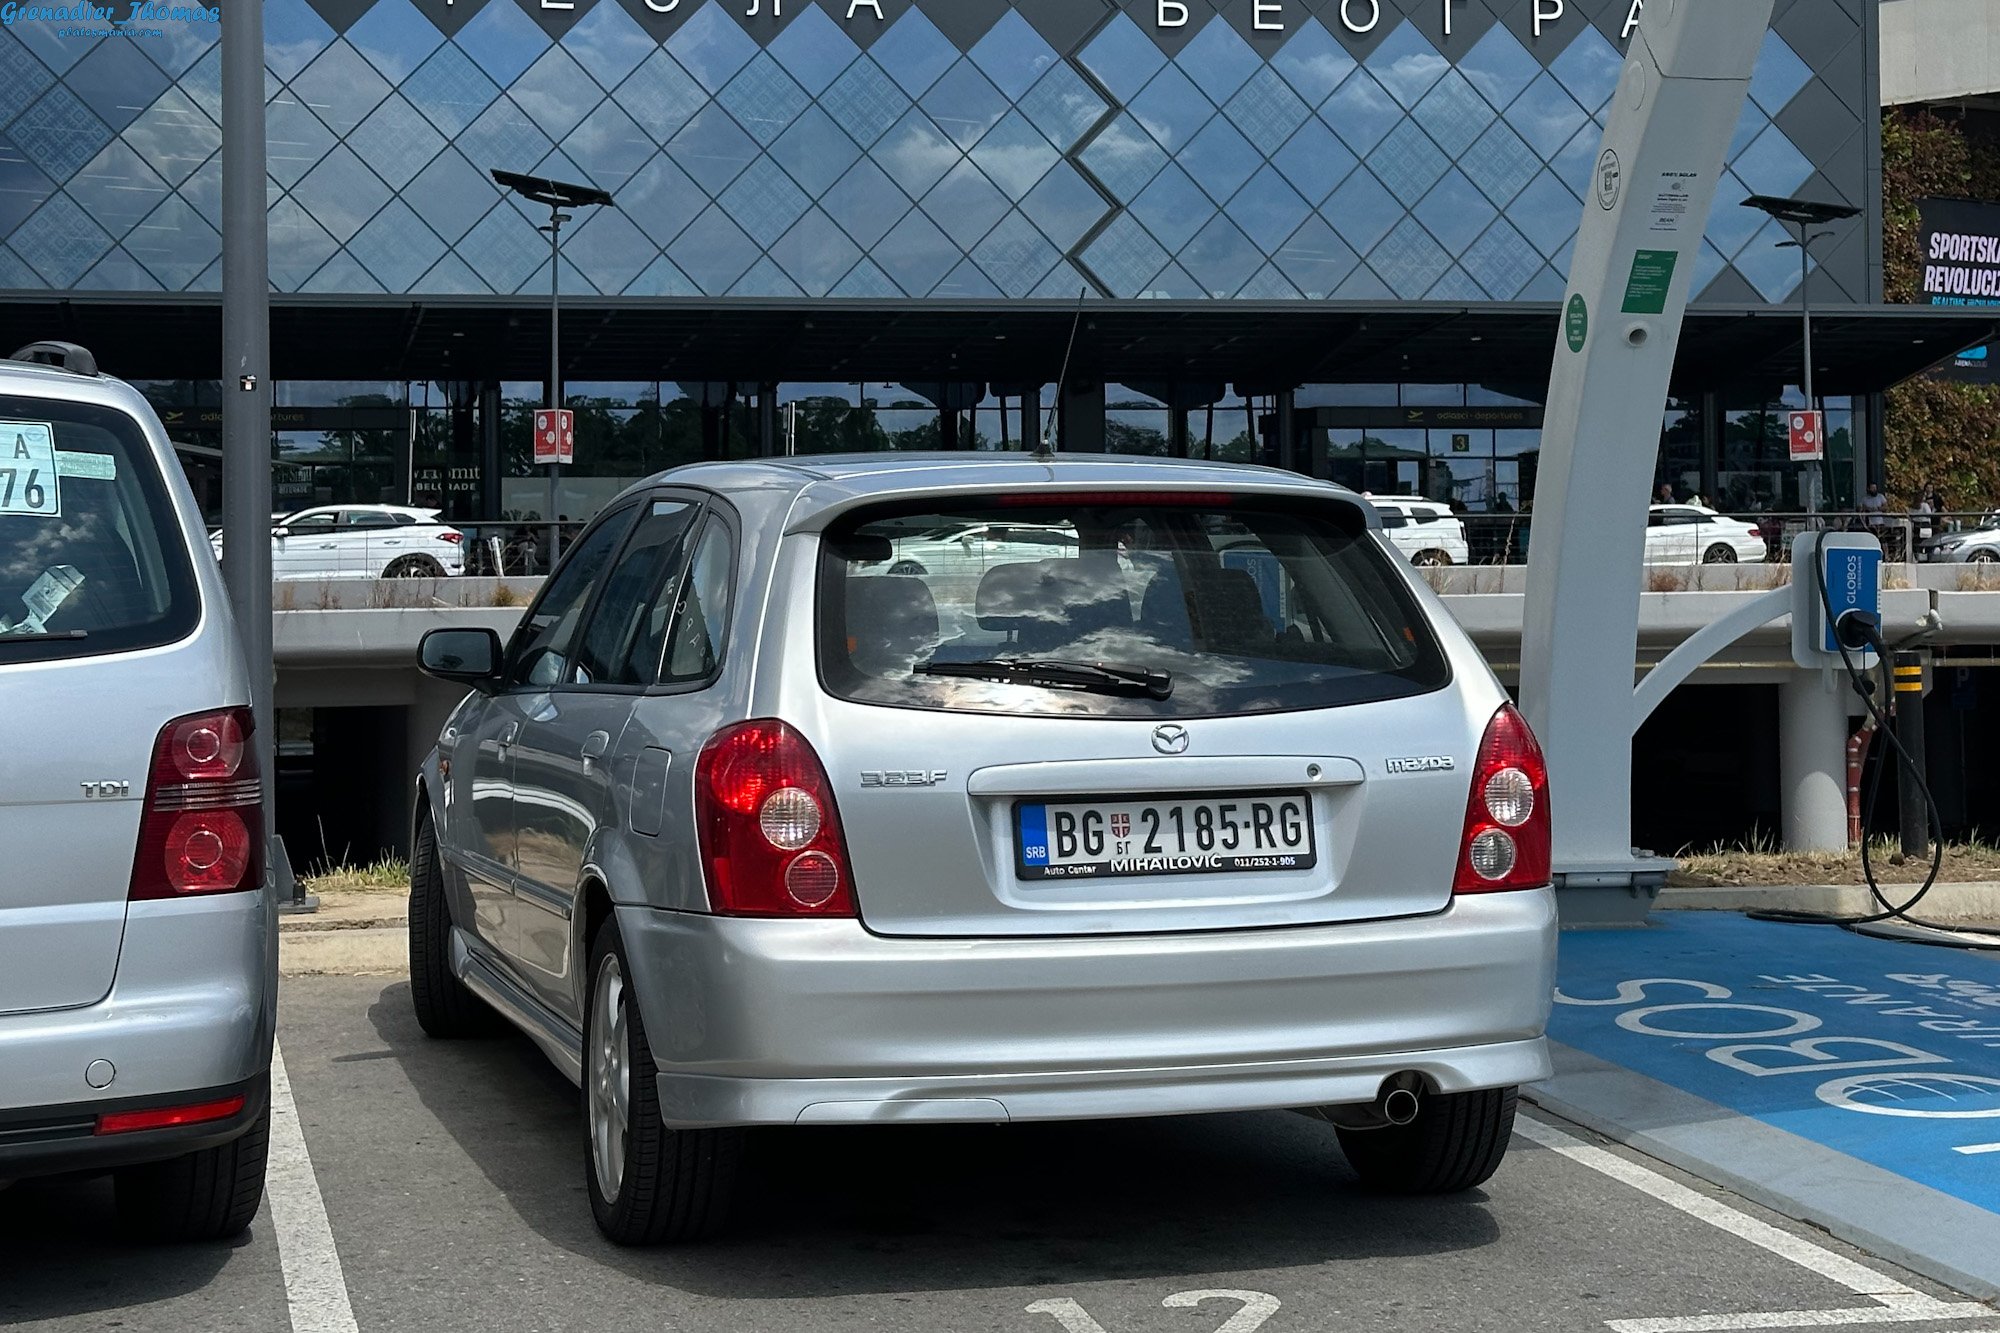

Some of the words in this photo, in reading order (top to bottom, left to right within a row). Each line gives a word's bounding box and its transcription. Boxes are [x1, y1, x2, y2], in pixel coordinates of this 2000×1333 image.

[14, 433, 31, 459] A
[1456, 436, 1466, 450] 3
[1847, 555, 1857, 604] GLOBOS
[861, 769, 948, 787] 323F
[81, 780, 129, 798] TDI
[1054, 809, 1104, 858] BG
[1025, 845, 1046, 860] SRB
[1116, 841, 1132, 855] БГ
[1044, 866, 1065, 876] Auto
[1110, 853, 1223, 872] MIHAILOVIĆ
